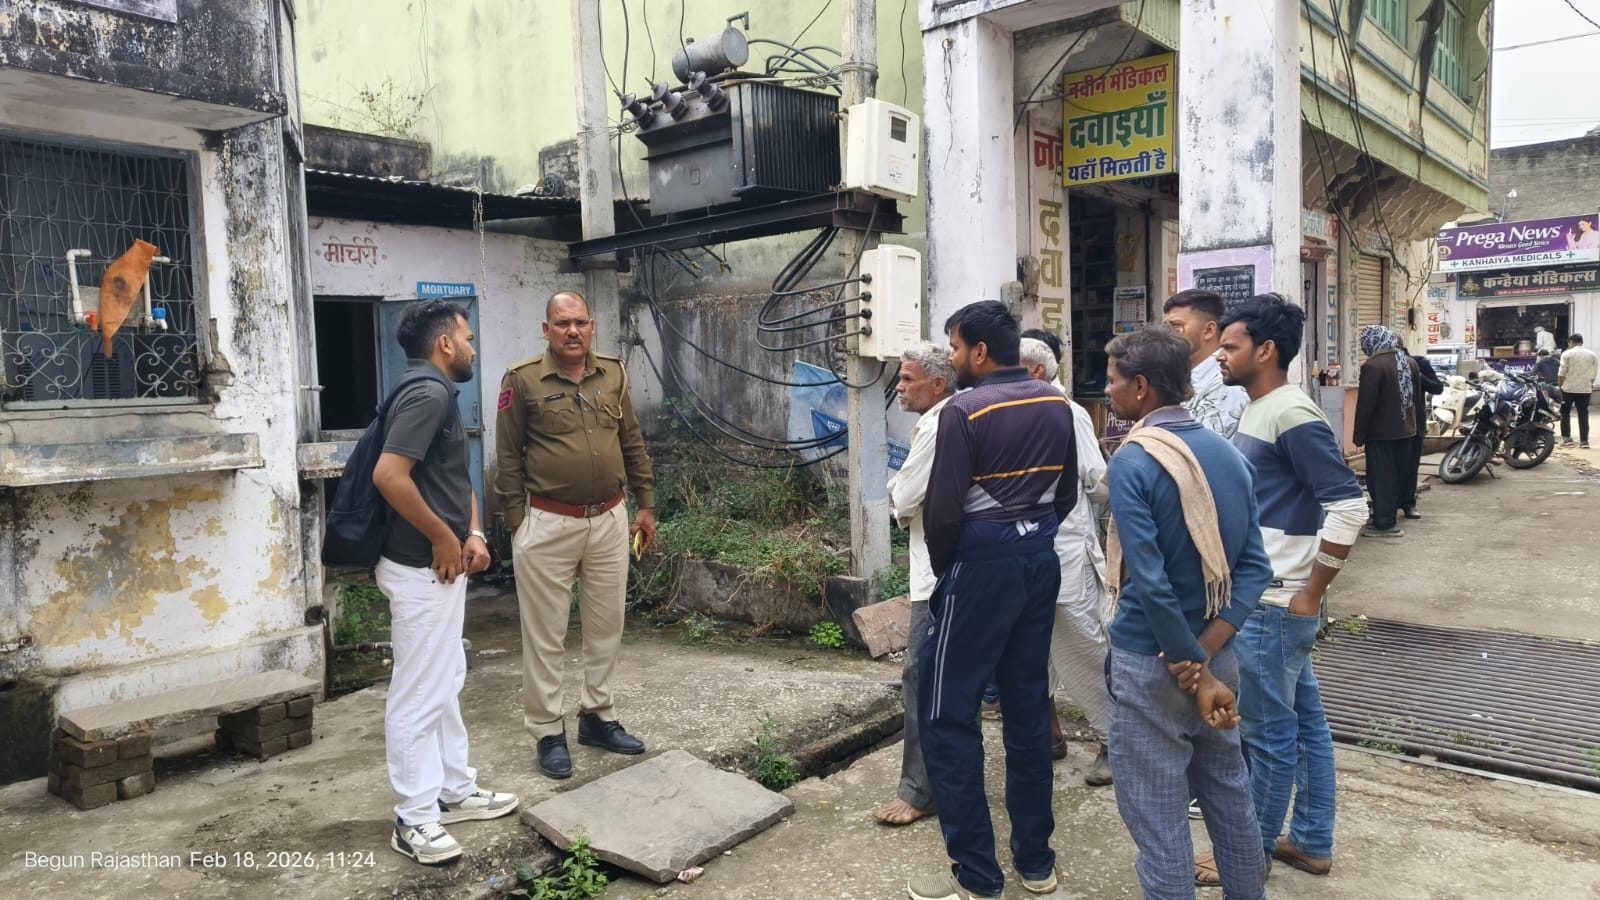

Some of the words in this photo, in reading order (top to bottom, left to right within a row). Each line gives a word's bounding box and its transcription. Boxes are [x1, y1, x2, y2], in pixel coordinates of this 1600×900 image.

[1067, 74, 1106, 98] नवीन
[1109, 64, 1169, 91] मेडिकल
[1068, 89, 1168, 148] दवाइयाँ
[1067, 157, 1098, 181] यहाँ
[1099, 151, 1152, 178] मिलती
[1151, 147, 1167, 170] है
[1455, 231, 1505, 248] Prega
[1508, 225, 1561, 242] News
[1462, 256, 1510, 267] KANHAIYA
[1512, 252, 1562, 263] MEDICALS
[421, 284, 471, 296] MORTUARY
[1483, 272, 1530, 289] कन्हैया
[1532, 270, 1598, 285] मेडिकल्स
